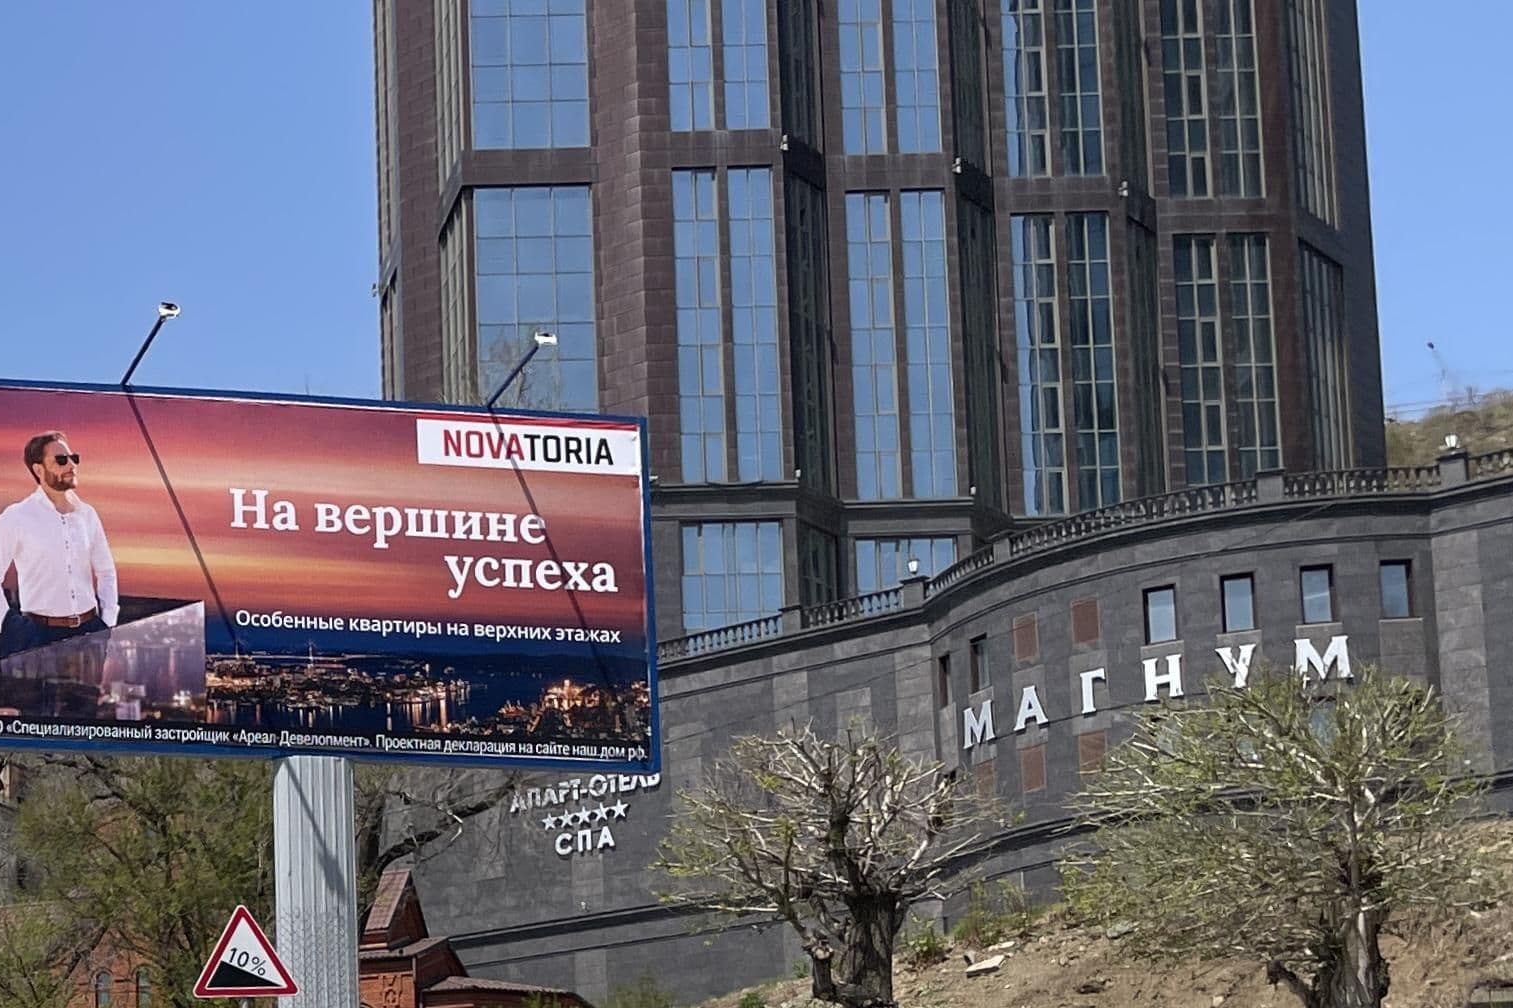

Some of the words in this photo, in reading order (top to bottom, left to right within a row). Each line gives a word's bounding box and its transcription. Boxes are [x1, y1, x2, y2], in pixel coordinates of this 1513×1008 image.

[443, 429, 614, 466] NOVATORIA
[229, 487, 300, 533] На
[314, 502, 546, 549] вершине
[444, 553, 619, 600] успеха
[236, 609, 344, 631] Особенные
[349, 617, 442, 638] квартиры
[446, 622, 469, 637] на
[474, 623, 552, 643] верхних
[555, 627, 622, 644] этажах
[963, 635, 1354, 751] МАГНУМ
[6, 719, 152, 740] «Специализированный
[154, 725, 230, 743] застройщик
[375, 733, 442, 752] Проектная
[443, 738, 516, 756] декларация
[518, 743, 532, 755] на
[535, 742, 569, 756] сайте
[554, 826, 616, 856] СПА
[229, 947, 266, 977] 10%
